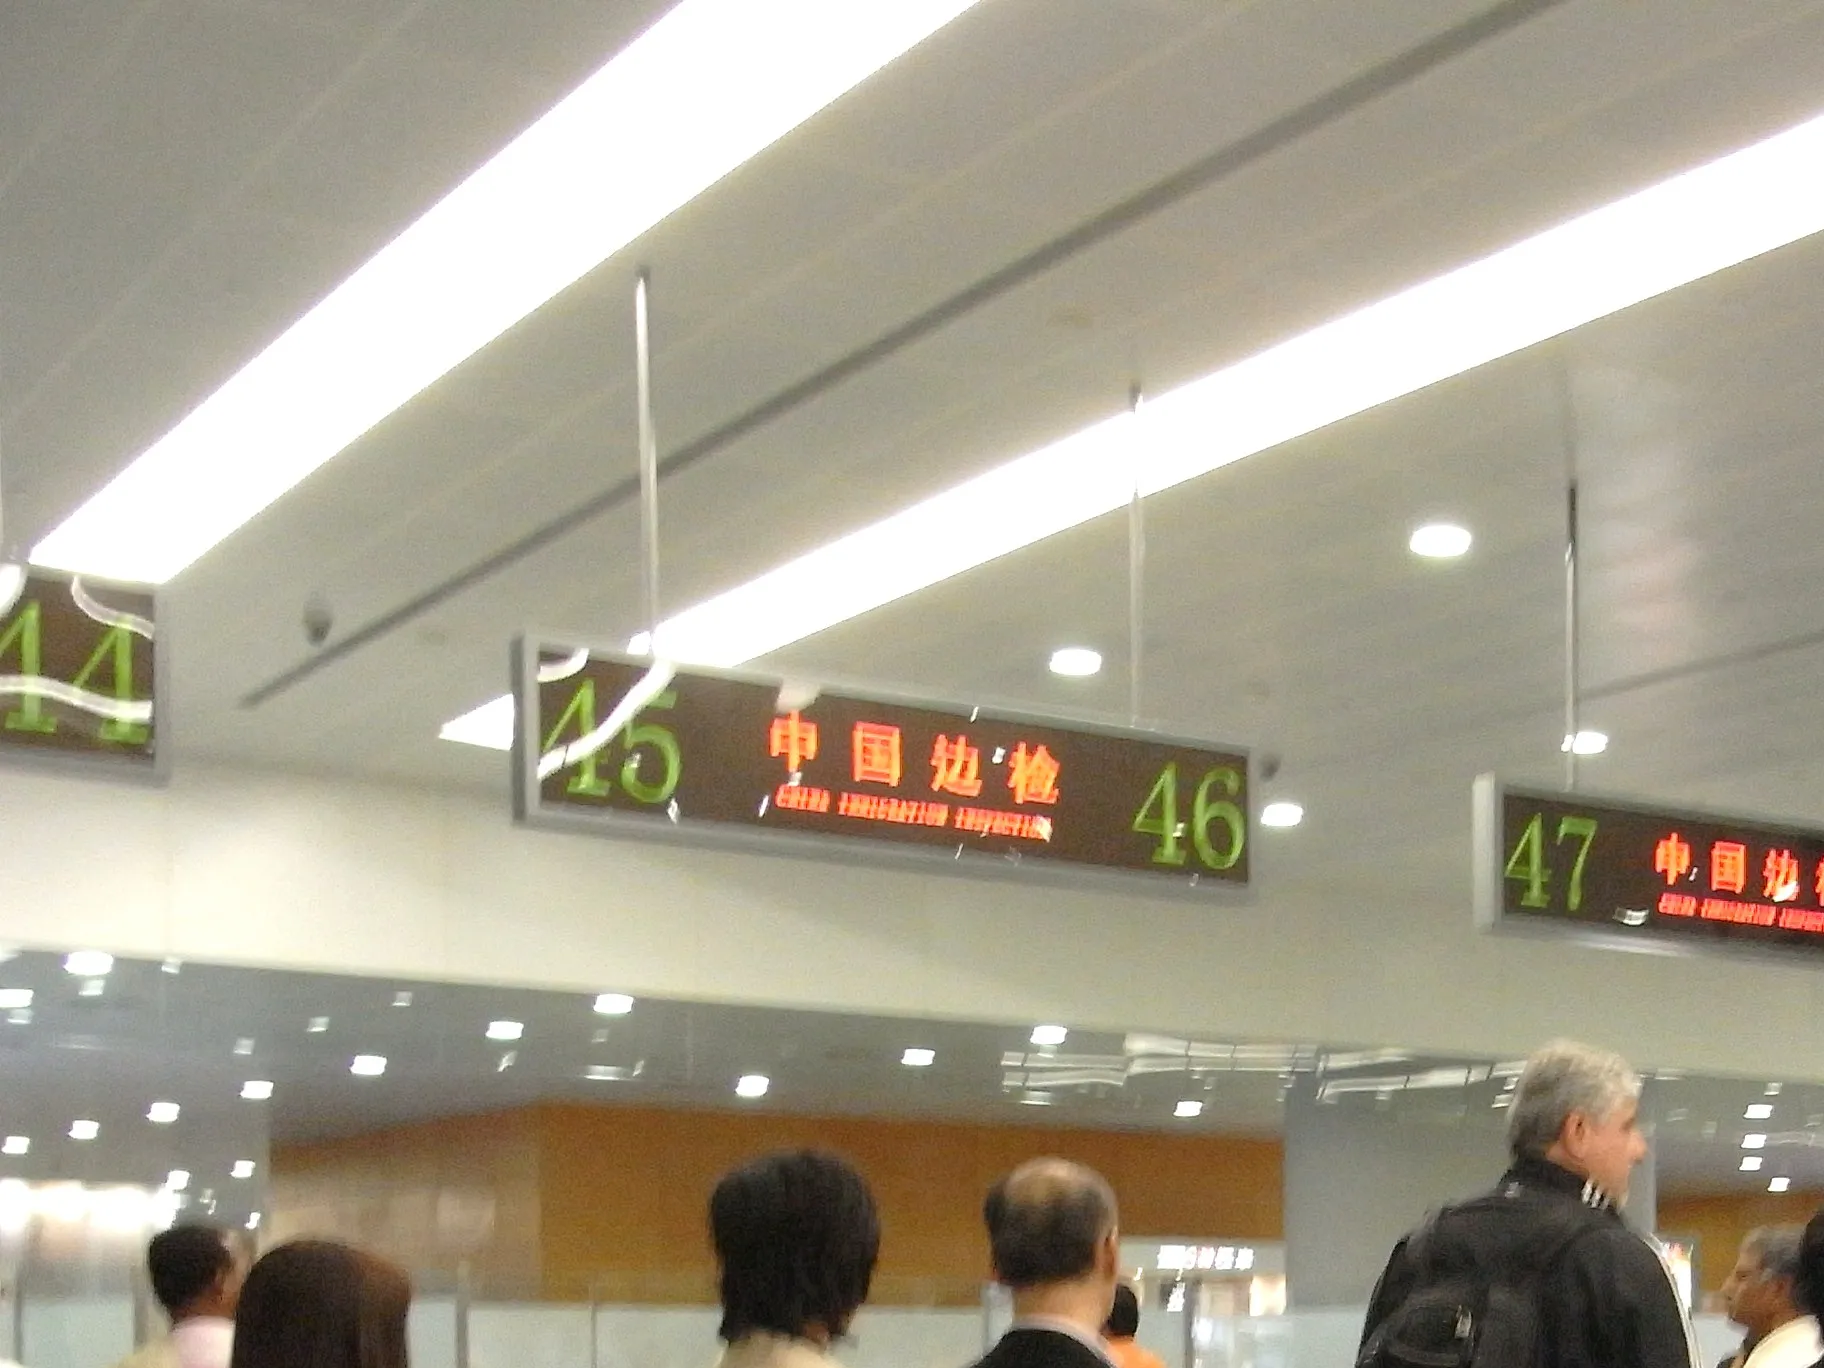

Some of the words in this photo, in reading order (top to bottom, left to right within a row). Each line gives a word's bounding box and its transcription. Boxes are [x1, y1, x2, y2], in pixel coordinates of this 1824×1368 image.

[0, 598, 150, 745] 44
[543, 678, 682, 804] 45
[769, 707, 1060, 805] 中国边检
[1132, 760, 1246, 870] 46
[1504, 812, 1598, 912] 47
